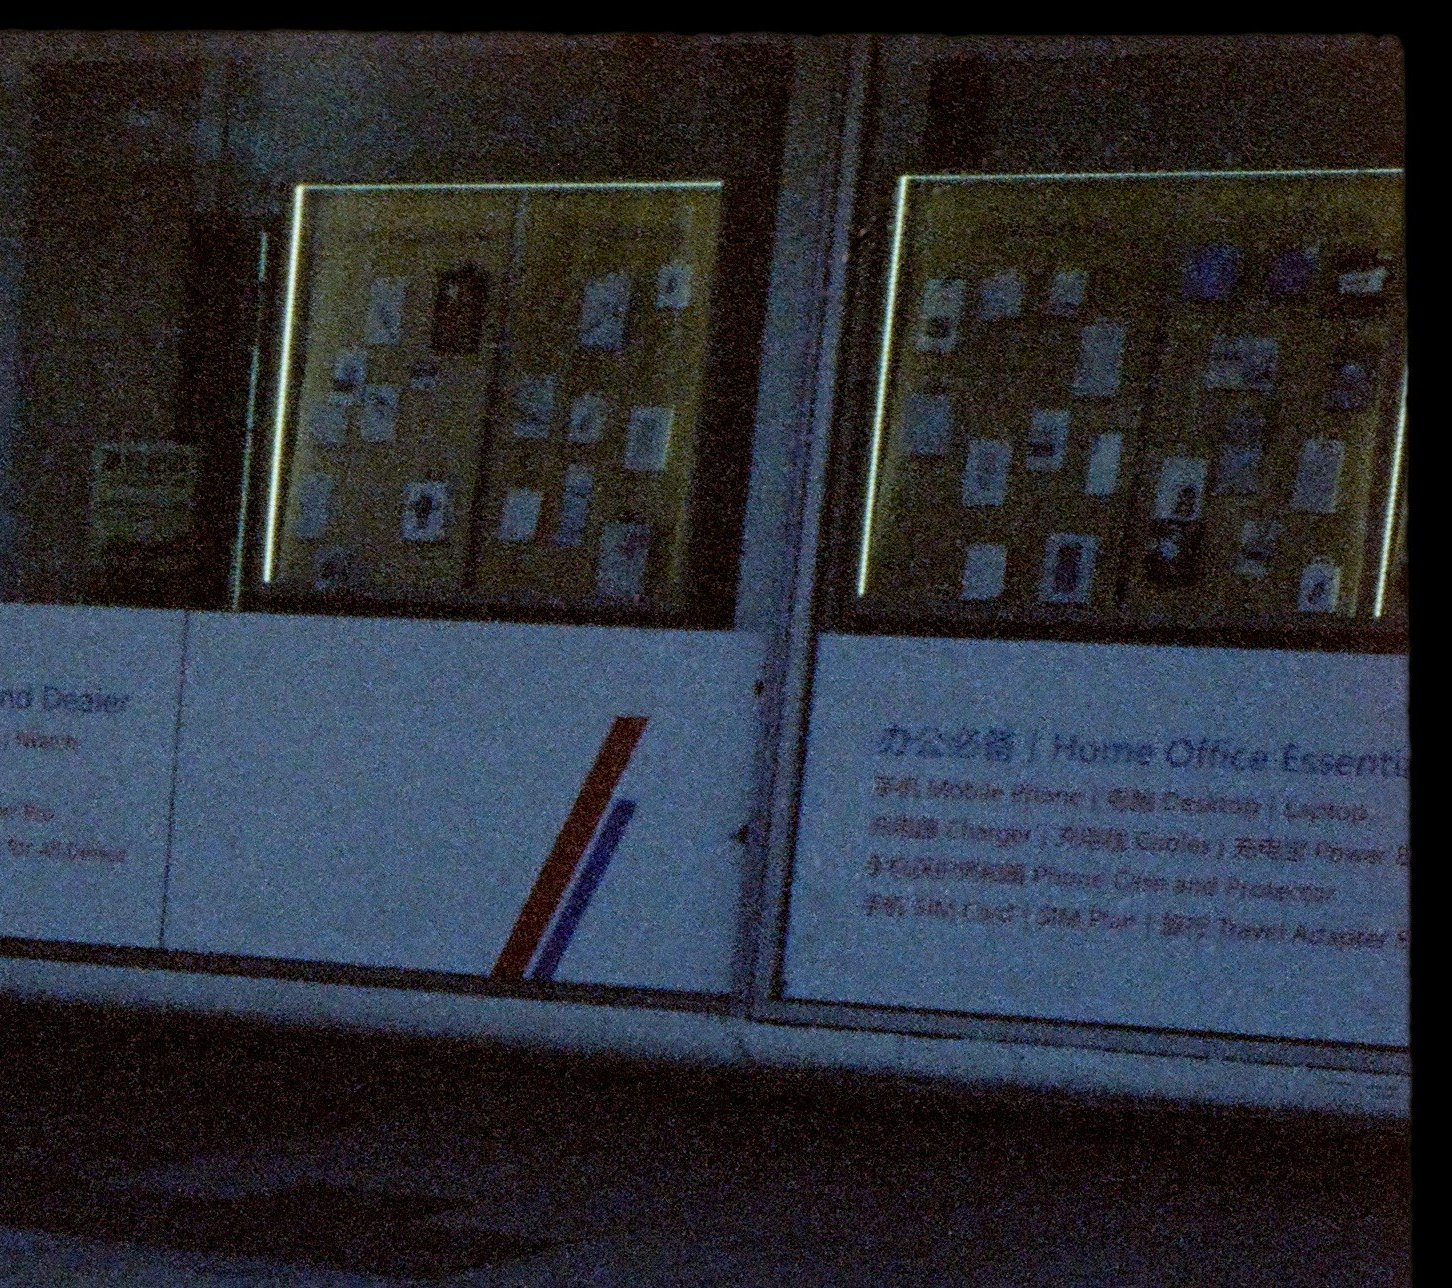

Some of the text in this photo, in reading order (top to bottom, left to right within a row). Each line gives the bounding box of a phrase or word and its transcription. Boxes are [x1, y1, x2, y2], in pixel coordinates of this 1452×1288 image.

[42, 684, 129, 713] Dealer
[1052, 733, 1155, 767] Home
[1164, 737, 1269, 773] Office
